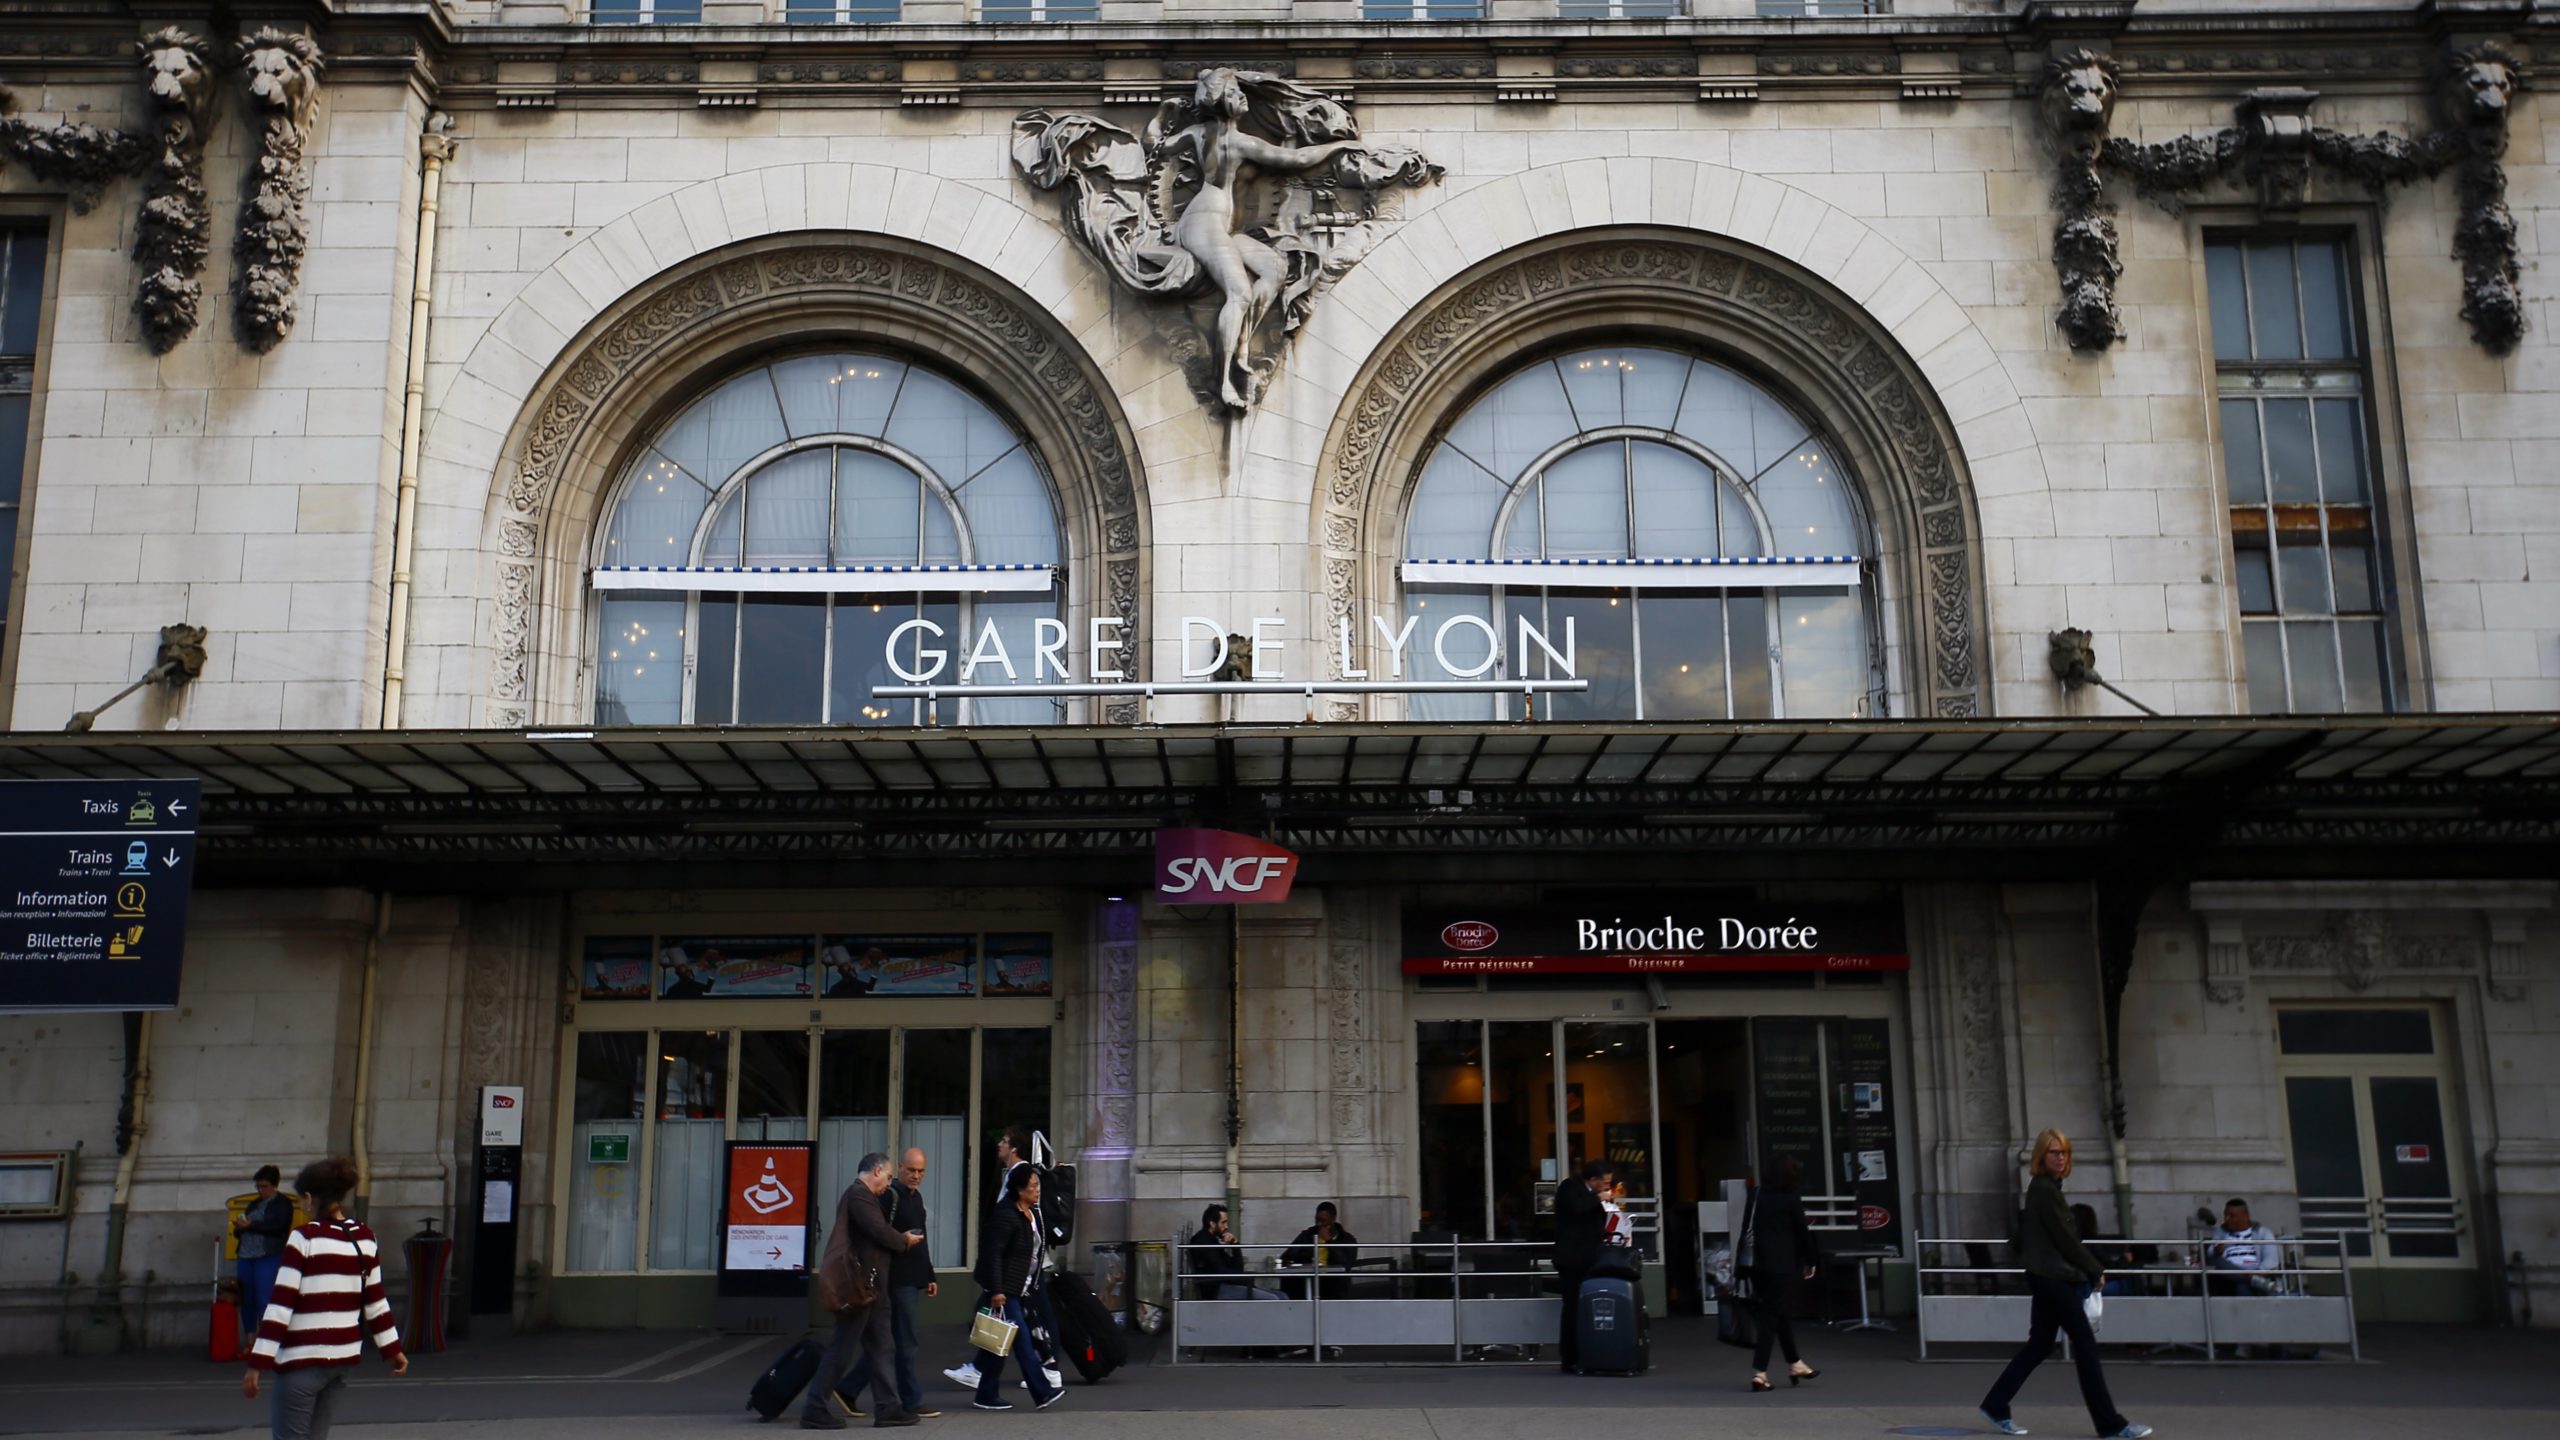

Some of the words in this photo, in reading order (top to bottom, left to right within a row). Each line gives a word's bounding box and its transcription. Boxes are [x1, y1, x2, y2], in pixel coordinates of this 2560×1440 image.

[885, 616, 1124, 682] GARE
[1181, 616, 1286, 679] DE
[1340, 614, 1576, 680] LYON
[82, 799, 119, 813] Taxis
[69, 850, 113, 864] Trains
[58, 868, 82, 877] Trains
[91, 868, 111, 876] Treni
[1160, 856, 1289, 893] SNCF
[16, 891, 108, 906] Information
[13, 910, 50, 919] reception
[57, 909, 107, 918] Informazioni
[1450, 925, 1491, 938] Brioche
[1576, 915, 1705, 951] Brioche
[1718, 916, 1818, 950] Dorée
[27, 932, 103, 948] Billetterie
[0, 952, 23, 960] Ticket
[25, 952, 48, 960] office
[56, 952, 101, 962] Biglietteria
[494, 1099, 513, 1108] SNCF
